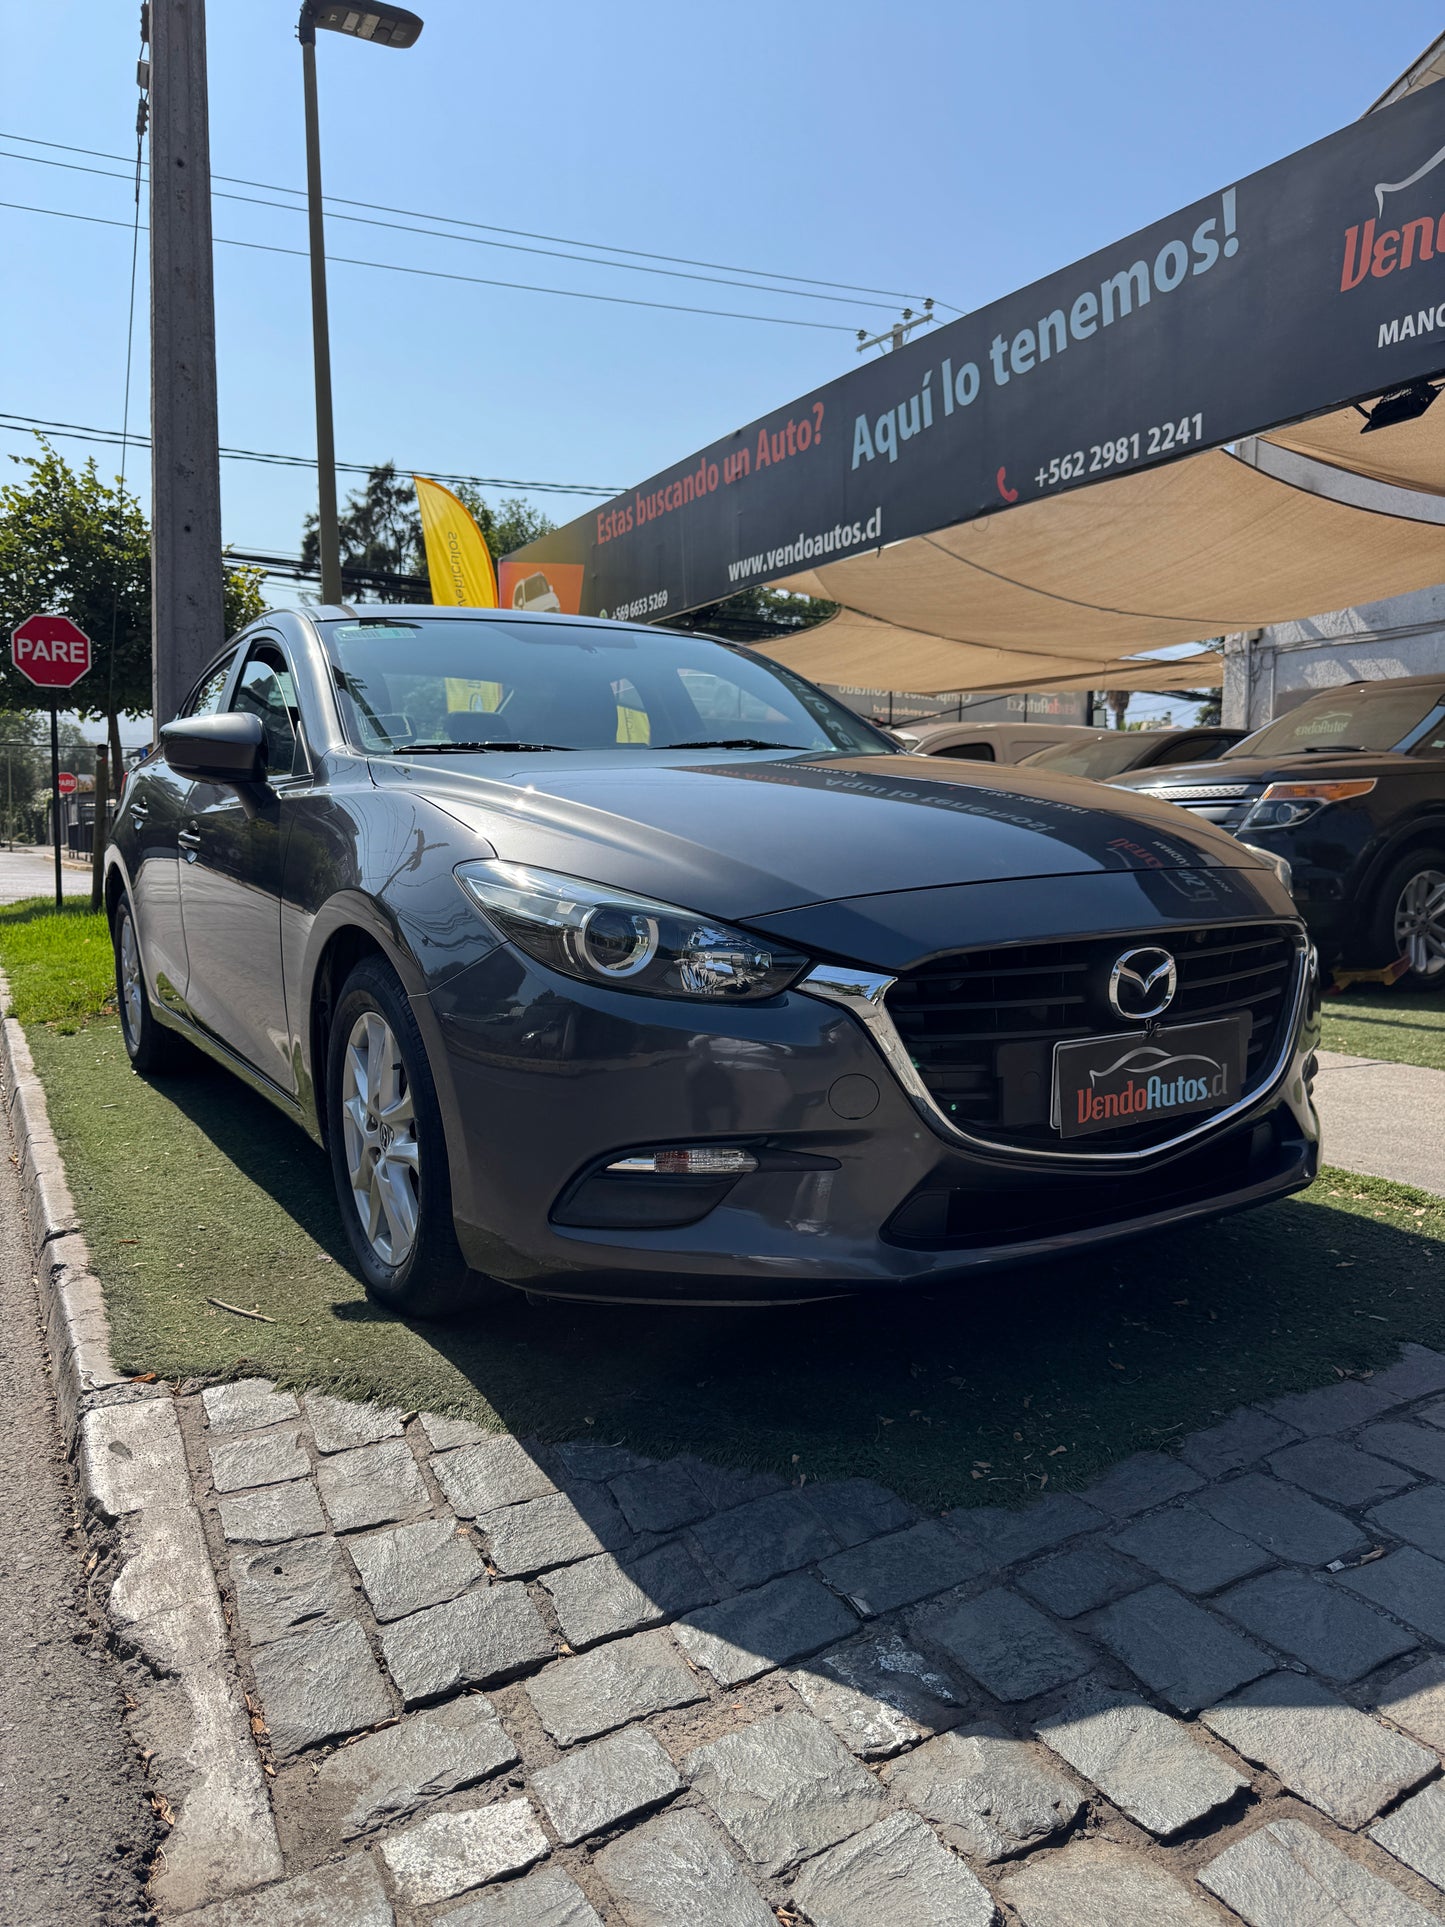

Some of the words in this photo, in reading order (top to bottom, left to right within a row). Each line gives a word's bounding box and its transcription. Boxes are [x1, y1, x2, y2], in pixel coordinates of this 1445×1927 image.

[1340, 211, 1445, 293] Ven
[851, 370, 934, 471] Aquí
[940, 358, 980, 416] lo
[989, 187, 1240, 386] tenemos!
[597, 504, 634, 545] Estas
[635, 456, 719, 527] buscando
[724, 446, 750, 485] un
[755, 402, 824, 472] Auto?
[1034, 443, 1085, 488] +562
[1090, 432, 1141, 473] 2981
[1147, 412, 1203, 456] 2241
[728, 507, 883, 582] www.vendoautos.cl
[630, 597, 648, 618] 6653
[648, 589, 668, 611] 5269
[17, 639, 85, 664] PARE
[1076, 1063, 1228, 1124] VendoAutos.cl
